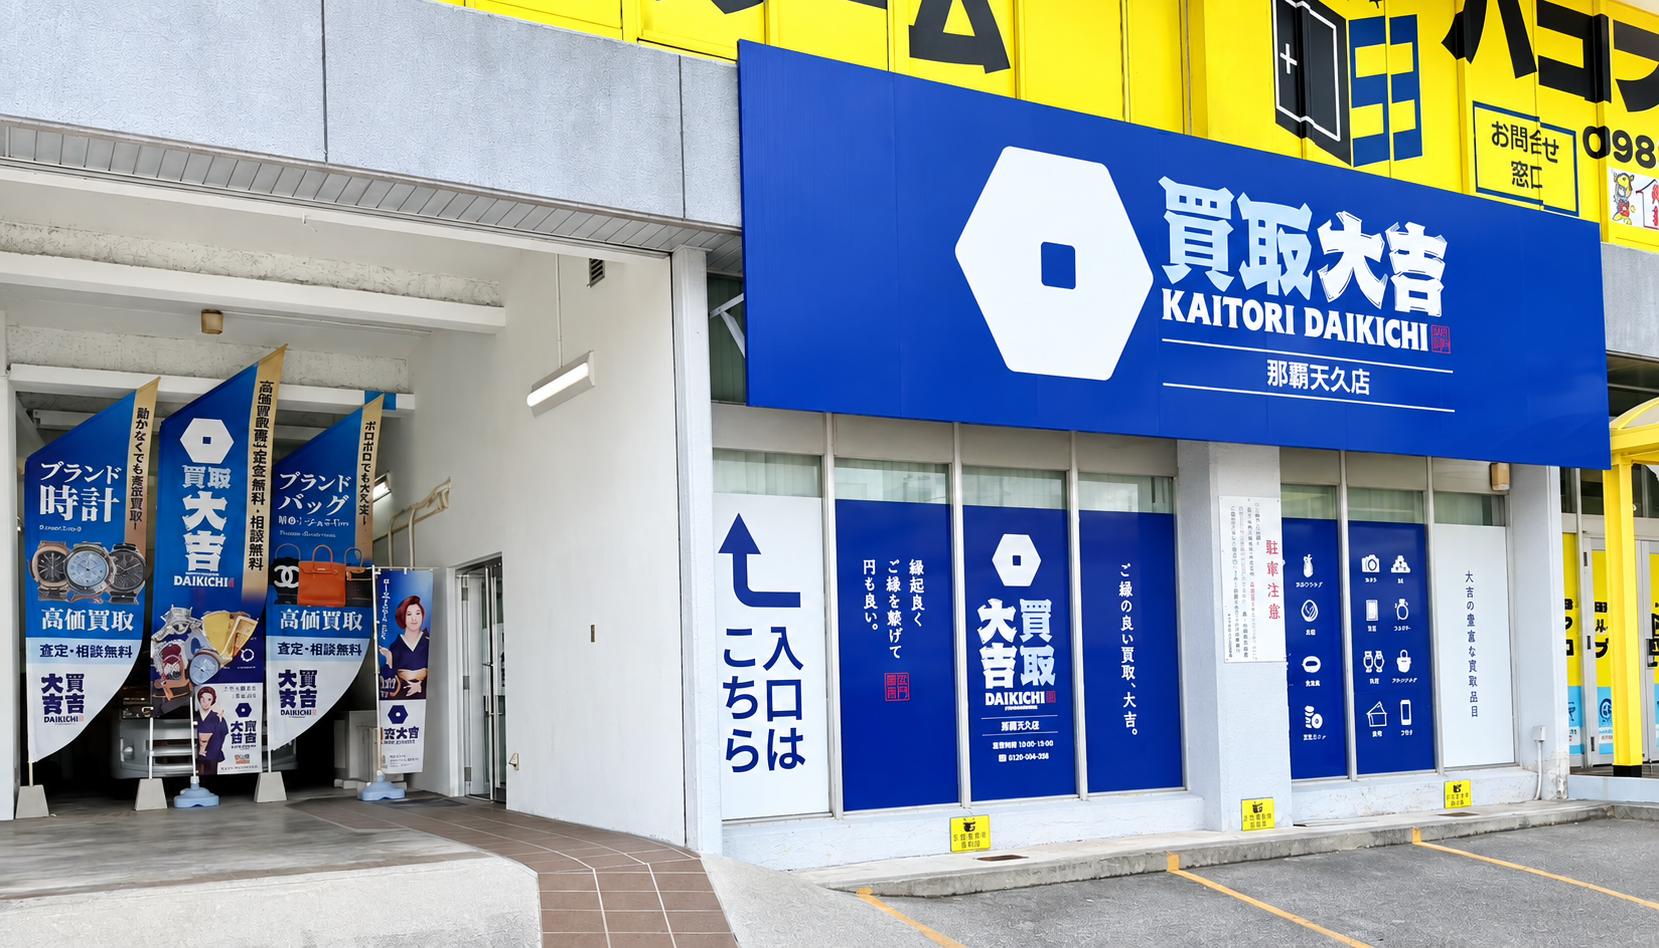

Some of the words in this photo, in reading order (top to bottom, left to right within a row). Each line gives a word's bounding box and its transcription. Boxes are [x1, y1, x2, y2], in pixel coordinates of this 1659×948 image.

[1491, 121, 1560, 163] お問合せ
[1158, 176, 1448, 317] 買取大吉
[1161, 288, 1295, 335] KAITORI
[1303, 306, 1429, 352] DAIKICHI
[1266, 359, 1370, 396] 那覇天久店
[40, 460, 122, 485] ブランド
[181, 464, 232, 489] 買取
[279, 470, 352, 493] ブランド
[39, 484, 120, 523] 時計
[277, 493, 350, 516] バッグ
[173, 575, 228, 588] DAIKICHI
[863, 559, 879, 631] 円も良い。
[909, 559, 925, 627] 縁起良く
[41, 607, 135, 632] 高価買取
[280, 608, 363, 632] 高価買取
[277, 641, 363, 657] 査定・相談無料
[976, 597, 1018, 689] 大吉
[1019, 598, 1056, 687] 買取
[1118, 563, 1138, 736] ご縁の良い買取、大吉。
[722, 627, 759, 773] こちら
[762, 626, 806, 771] 入口は
[985, 691, 1046, 706] DAIKICHI
[43, 715, 79, 723] DAIKICHI
